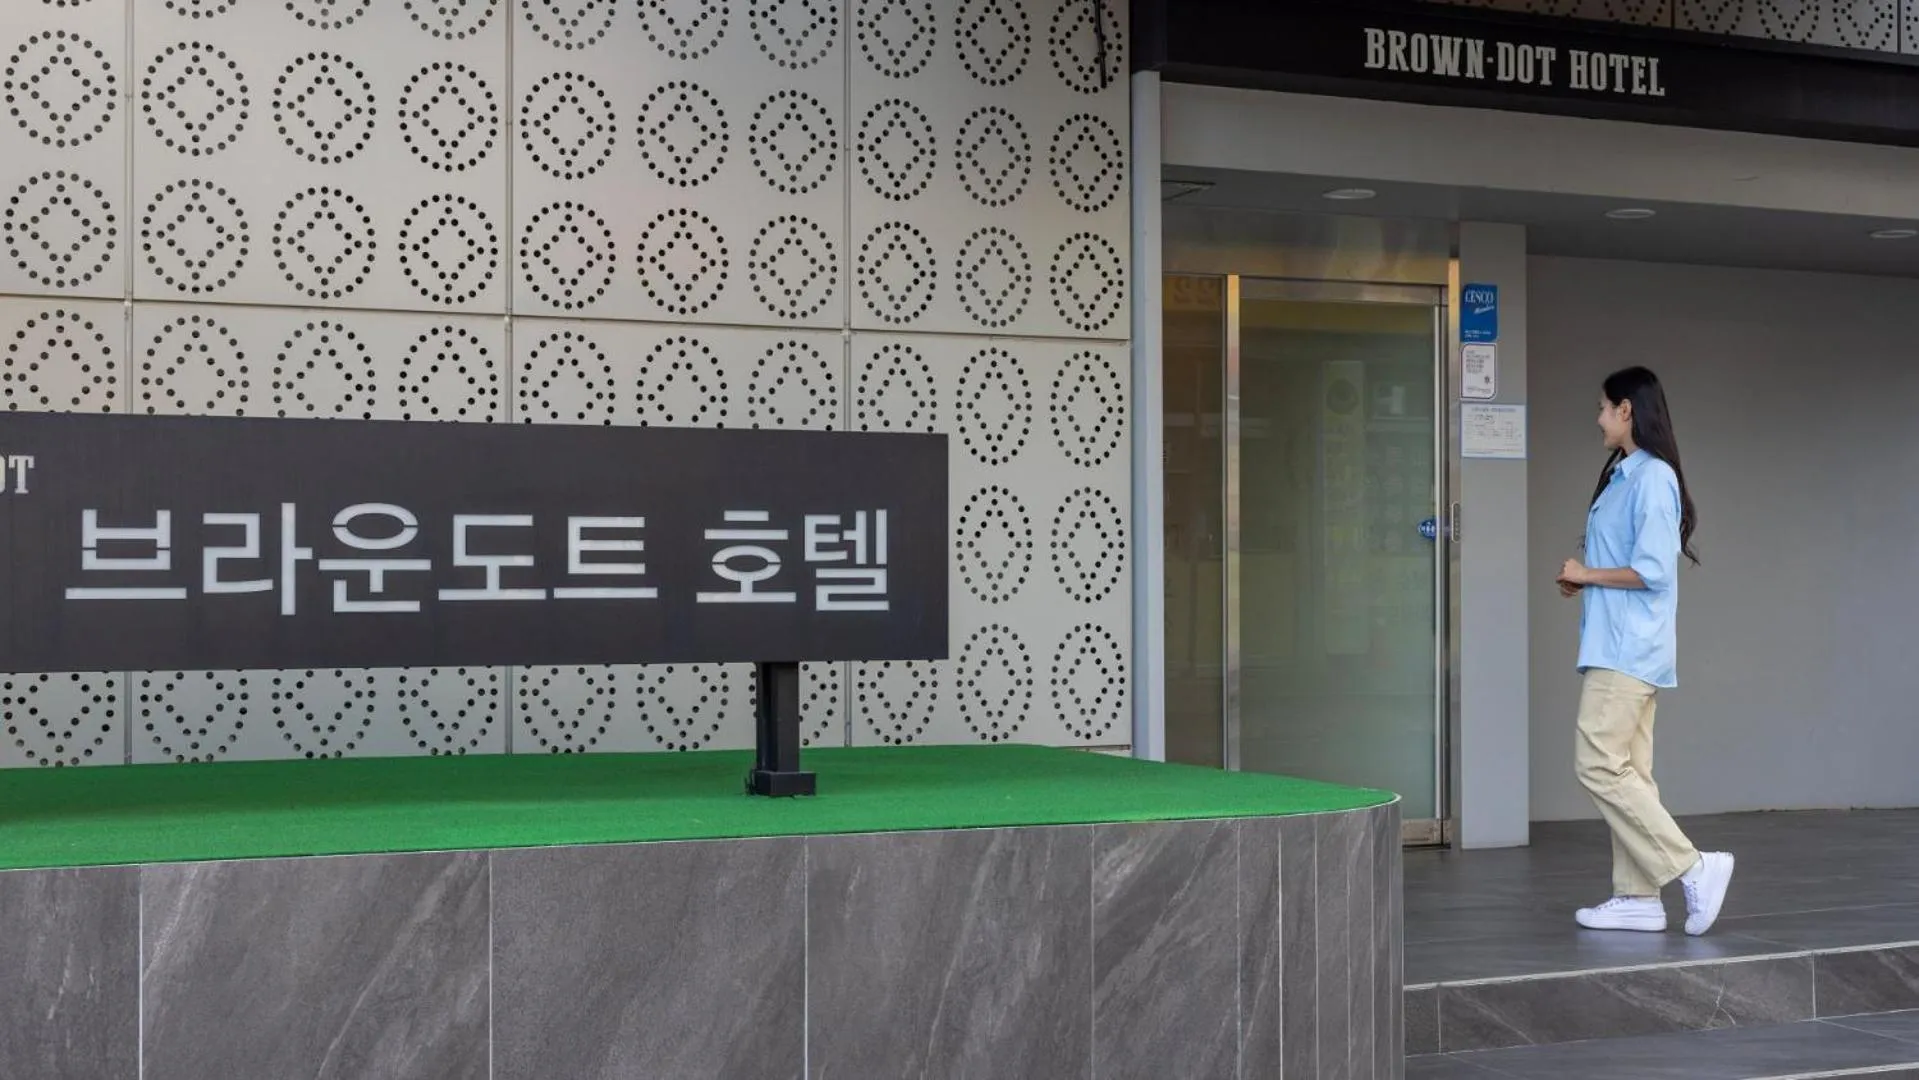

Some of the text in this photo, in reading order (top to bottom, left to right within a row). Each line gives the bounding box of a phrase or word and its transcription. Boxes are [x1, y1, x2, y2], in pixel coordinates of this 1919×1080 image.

[1569, 50, 1665, 96] HOTEL
[66, 503, 889, 615] 브라운도트 호텔
